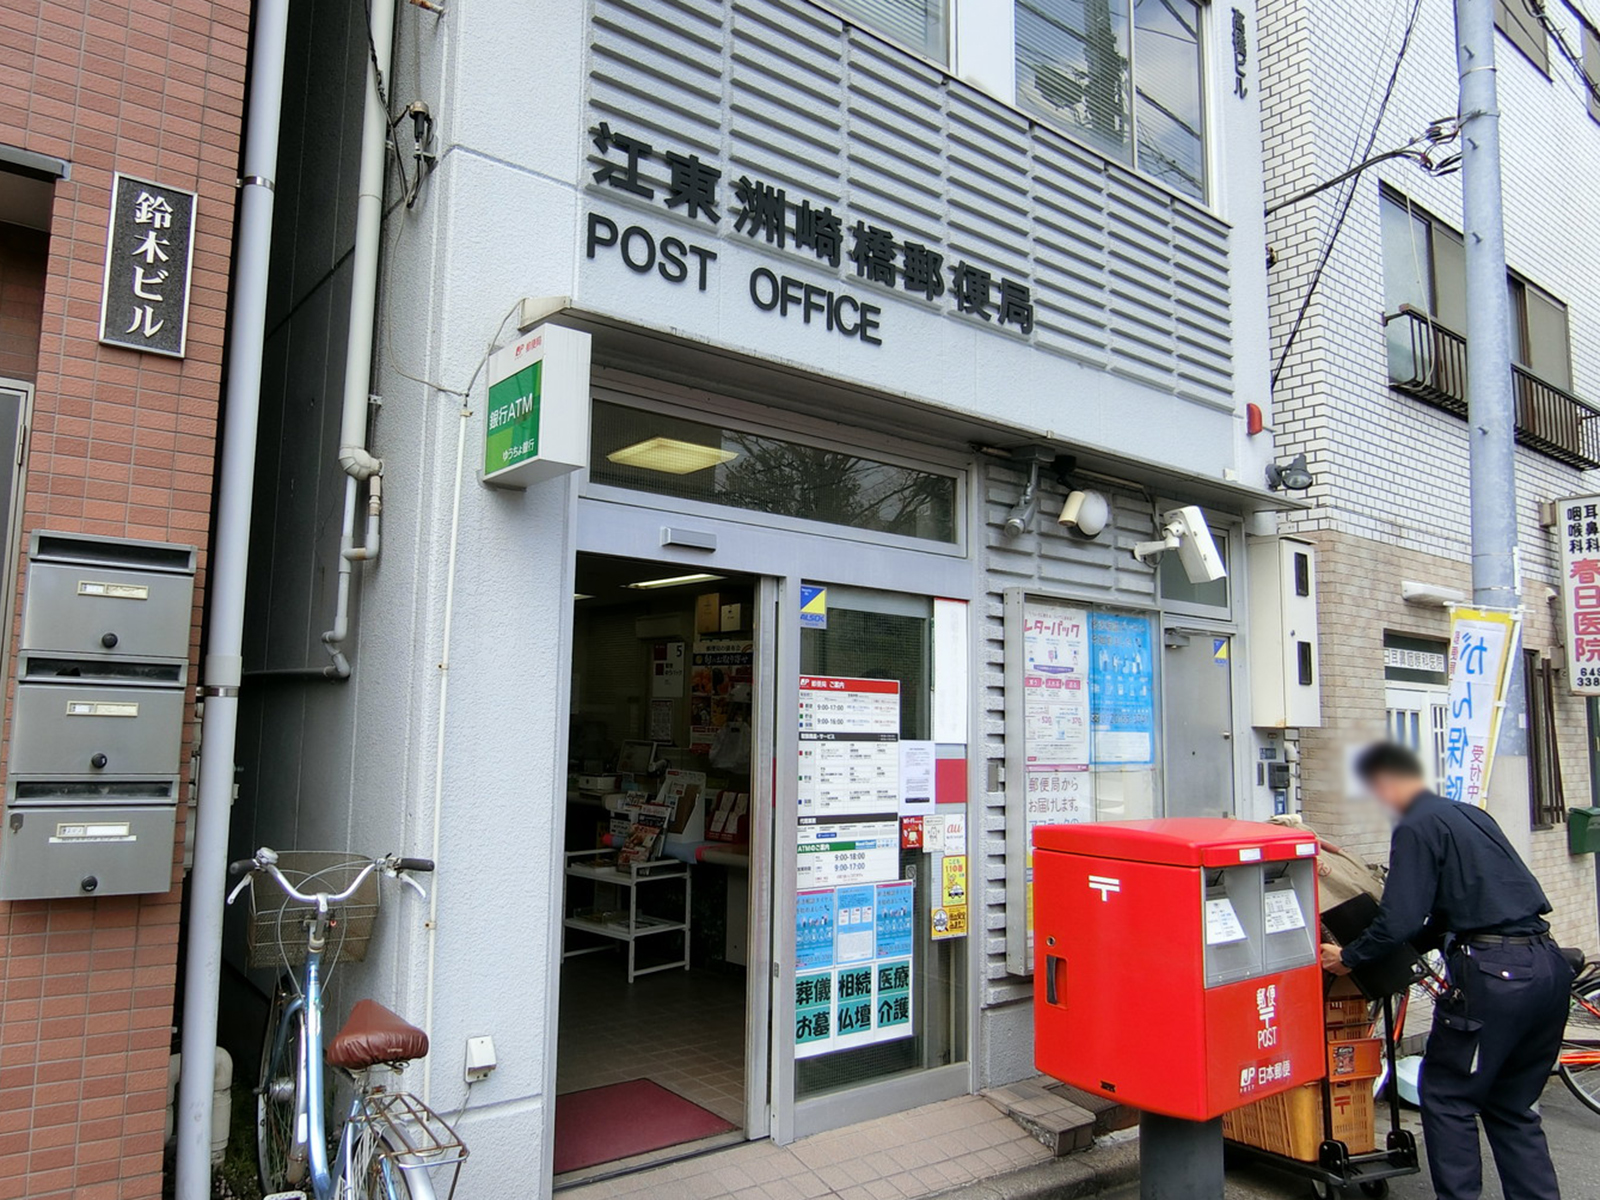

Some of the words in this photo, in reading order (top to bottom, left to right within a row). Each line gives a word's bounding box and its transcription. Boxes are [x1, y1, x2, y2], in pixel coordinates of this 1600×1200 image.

[592, 121, 1034, 335] 江東洲崎橋郵便局
[126, 191, 173, 338] 鈴木ビル
[587, 212, 717, 291] POST
[750, 267, 882, 346] OFFICE
[489, 393, 533, 430] 銀行ATM
[502, 438, 534, 461] ゆうちょ銀行
[1567, 506, 1583, 554] 咽喉科
[1024, 619, 1080, 638] レターパック
[676, 645, 683, 657] 5
[817, 703, 845, 712] 9:00-17:00
[817, 717, 845, 725] 9:00-16:00
[1028, 777, 1079, 792] 郵便局から
[1028, 797, 1079, 813] お届けします。
[947, 824, 962, 834] au
[834, 853, 866, 862] 9:00-18:00
[834, 862, 866, 871] 9:00-17:00
[796, 977, 831, 1005] 葬儀
[838, 971, 871, 998] 相続
[879, 965, 909, 992] 医療
[878, 997, 909, 1023] 介護
[1257, 985, 1276, 1010] 郵便
[796, 1011, 830, 1039] お墓
[838, 1004, 871, 1031] 仏壇
[1258, 1026, 1277, 1049] POST
[1258, 1060, 1291, 1085] 日本郵便
